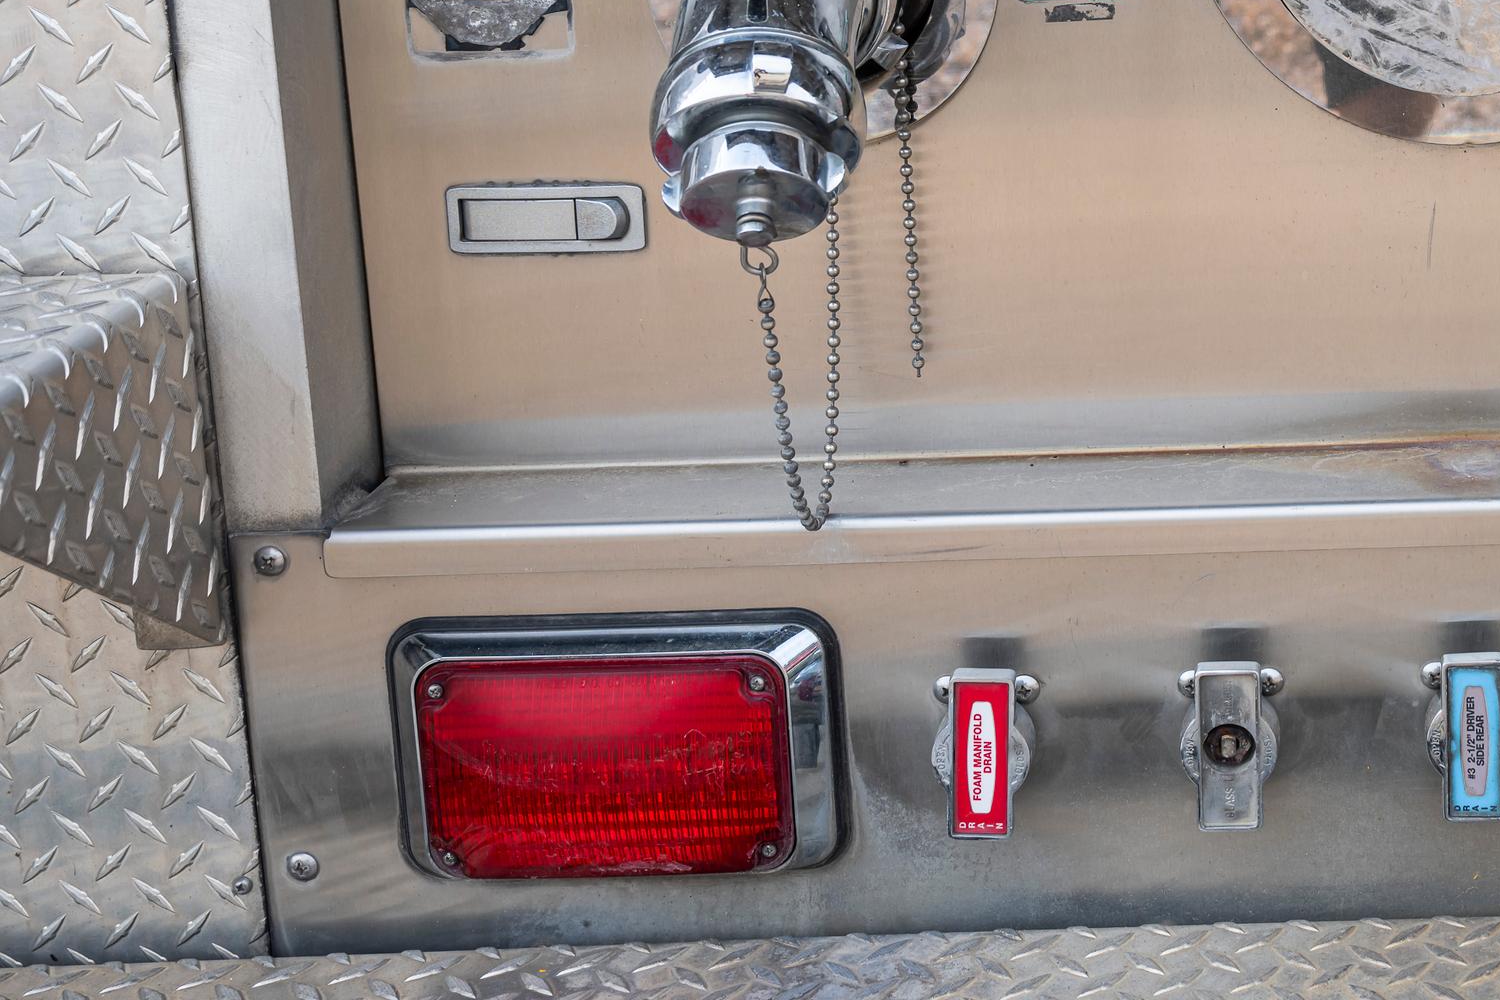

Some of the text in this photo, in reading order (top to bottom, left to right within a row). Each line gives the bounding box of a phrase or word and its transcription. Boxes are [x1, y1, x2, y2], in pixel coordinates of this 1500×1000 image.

[1466, 696, 1475, 732] DRIVER
[972, 713, 982, 801] FOAM MANIFOLD
[983, 741, 992, 774] DRAIN
[1475, 714, 1485, 767] SIDE REAR
[1467, 767, 1476, 779] #3
